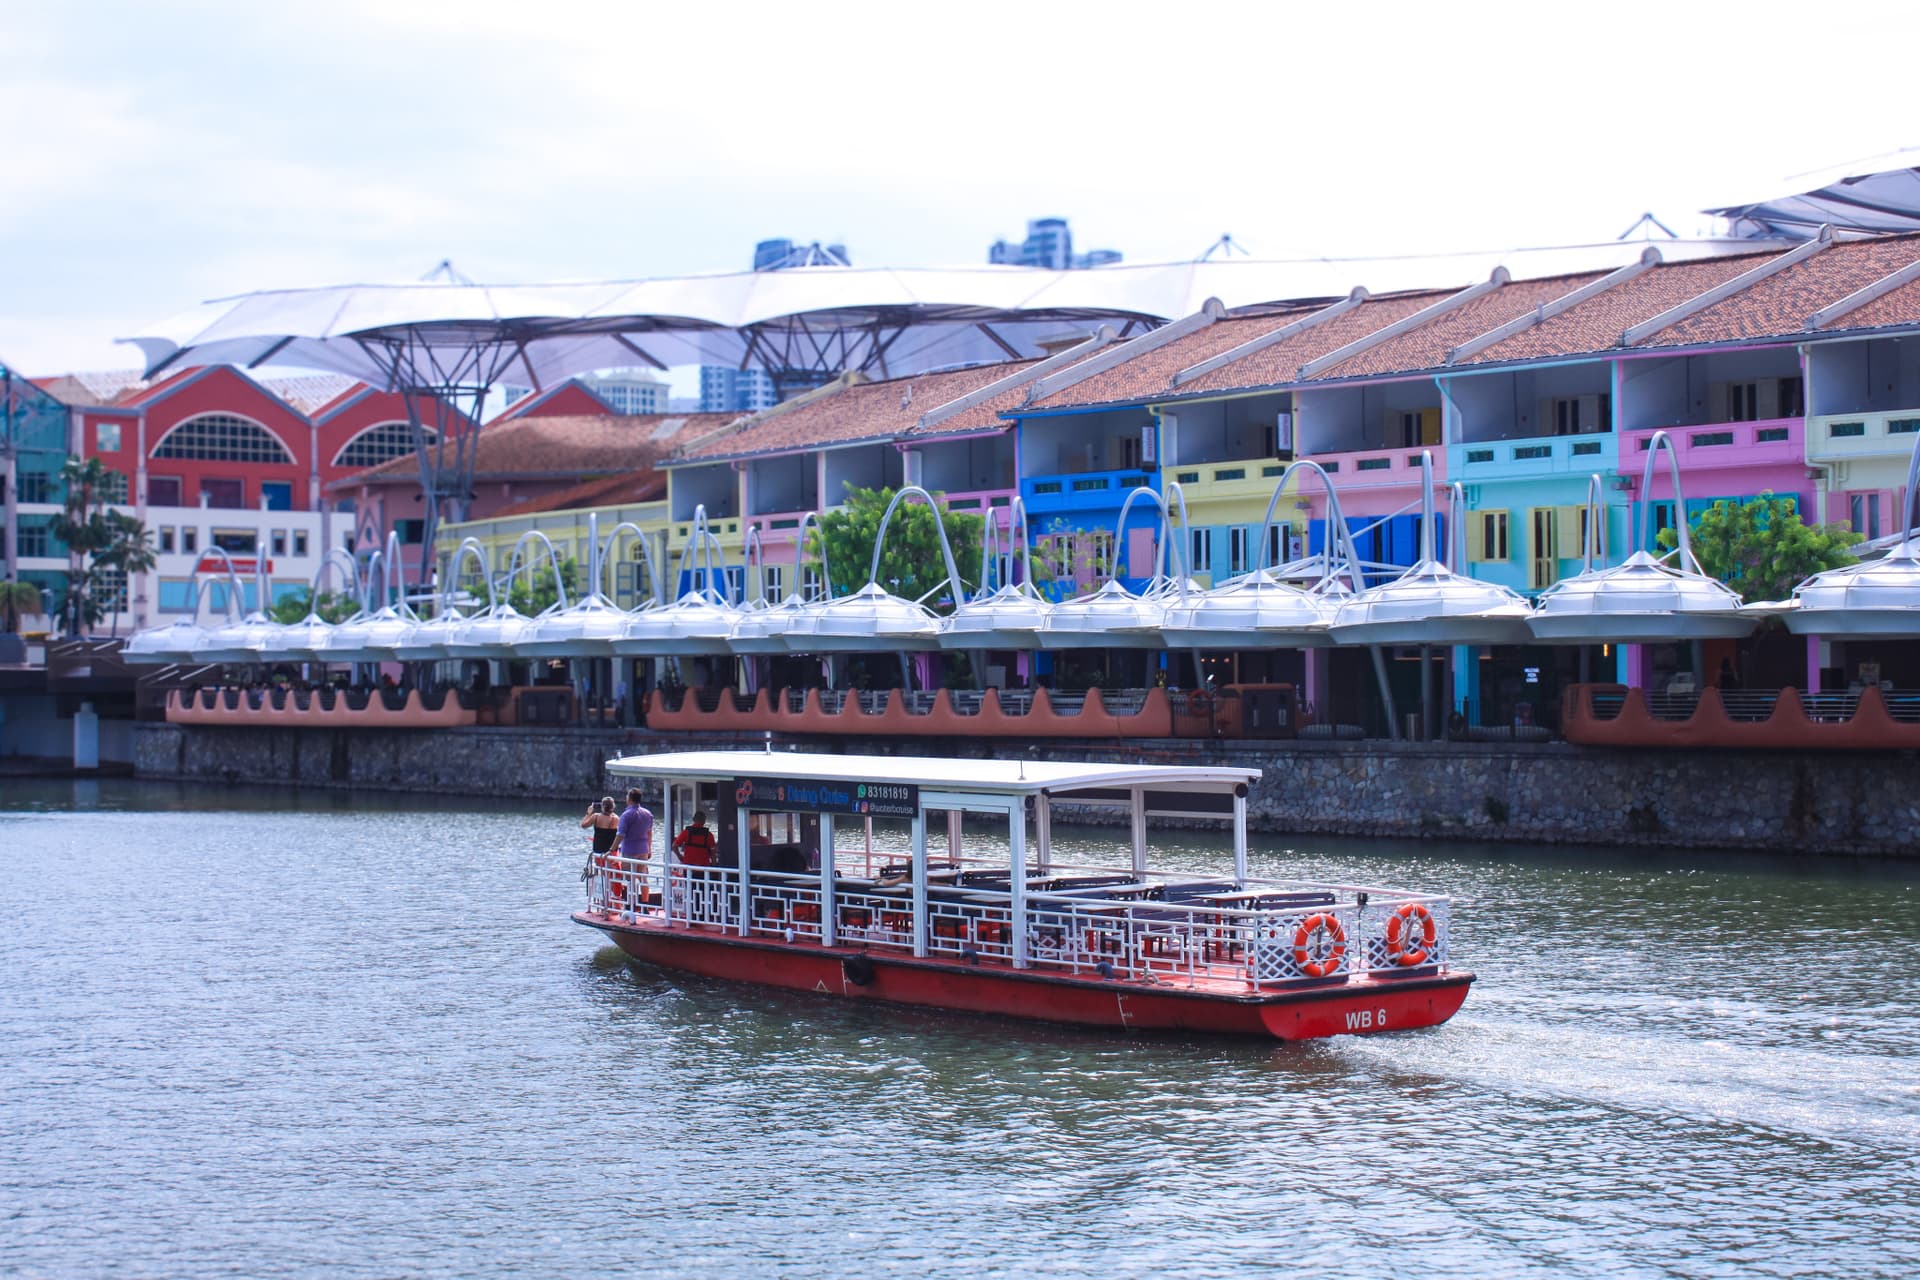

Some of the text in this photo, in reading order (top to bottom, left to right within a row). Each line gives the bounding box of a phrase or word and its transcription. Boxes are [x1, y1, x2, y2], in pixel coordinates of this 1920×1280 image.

[787, 785, 817, 806] Dining
[819, 787, 849, 805] Cruise
[869, 786, 909, 801] 83181819
[1345, 1008, 1387, 1030] WB 6
